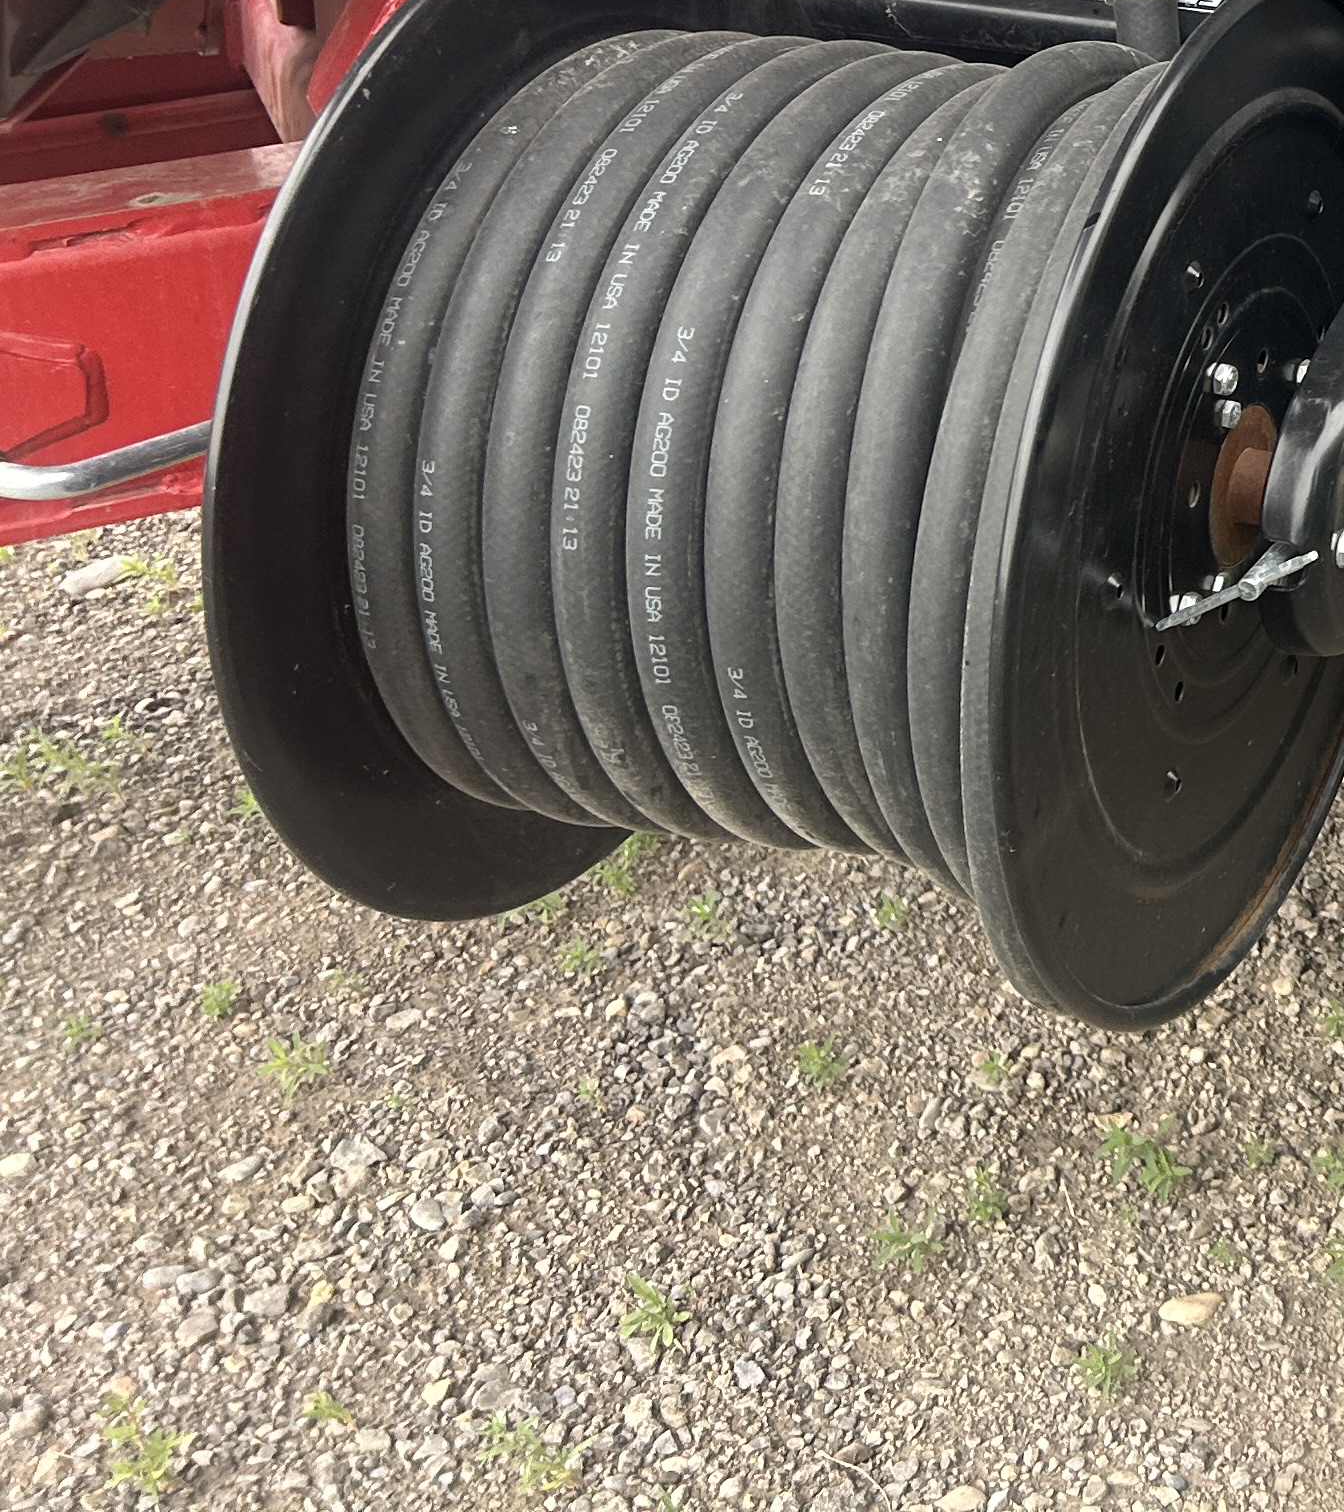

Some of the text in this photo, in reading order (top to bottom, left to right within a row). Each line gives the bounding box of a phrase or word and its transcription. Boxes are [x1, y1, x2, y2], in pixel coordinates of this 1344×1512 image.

[619, 99, 660, 133] 12101
[695, 120, 718, 134] ID
[572, 148, 618, 206] 082423
[659, 139, 700, 185] AG200
[427, 202, 447, 221] ID
[633, 191, 668, 233] MADE
[397, 229, 431, 287] AG200
[618, 243, 641, 265] IN
[602, 273, 628, 310] USA
[378, 297, 404, 346] MADE
[582, 322, 612, 379] 12101
[671, 326, 696, 363] 3/4
[368, 359, 385, 383] IN
[662, 378, 683, 401] ID
[359, 393, 377, 431] USA
[565, 404, 592, 482] 082423
[649, 412, 675, 478] AG200
[352, 444, 369, 500] 12101
[420, 459, 436, 497] 3/4
[418, 510, 433, 534] ID
[644, 488, 665, 540] MADE
[419, 542, 435, 602] AG200
[644, 554, 662, 576] IN
[644, 586, 663, 623] USA
[424, 609, 443, 655] MADE
[434, 663, 451, 684] IN
[648, 634, 672, 685] 12101
[727, 667, 748, 699] 3/4
[736, 710, 754, 729] ID
[744, 735, 773, 779] AG200
